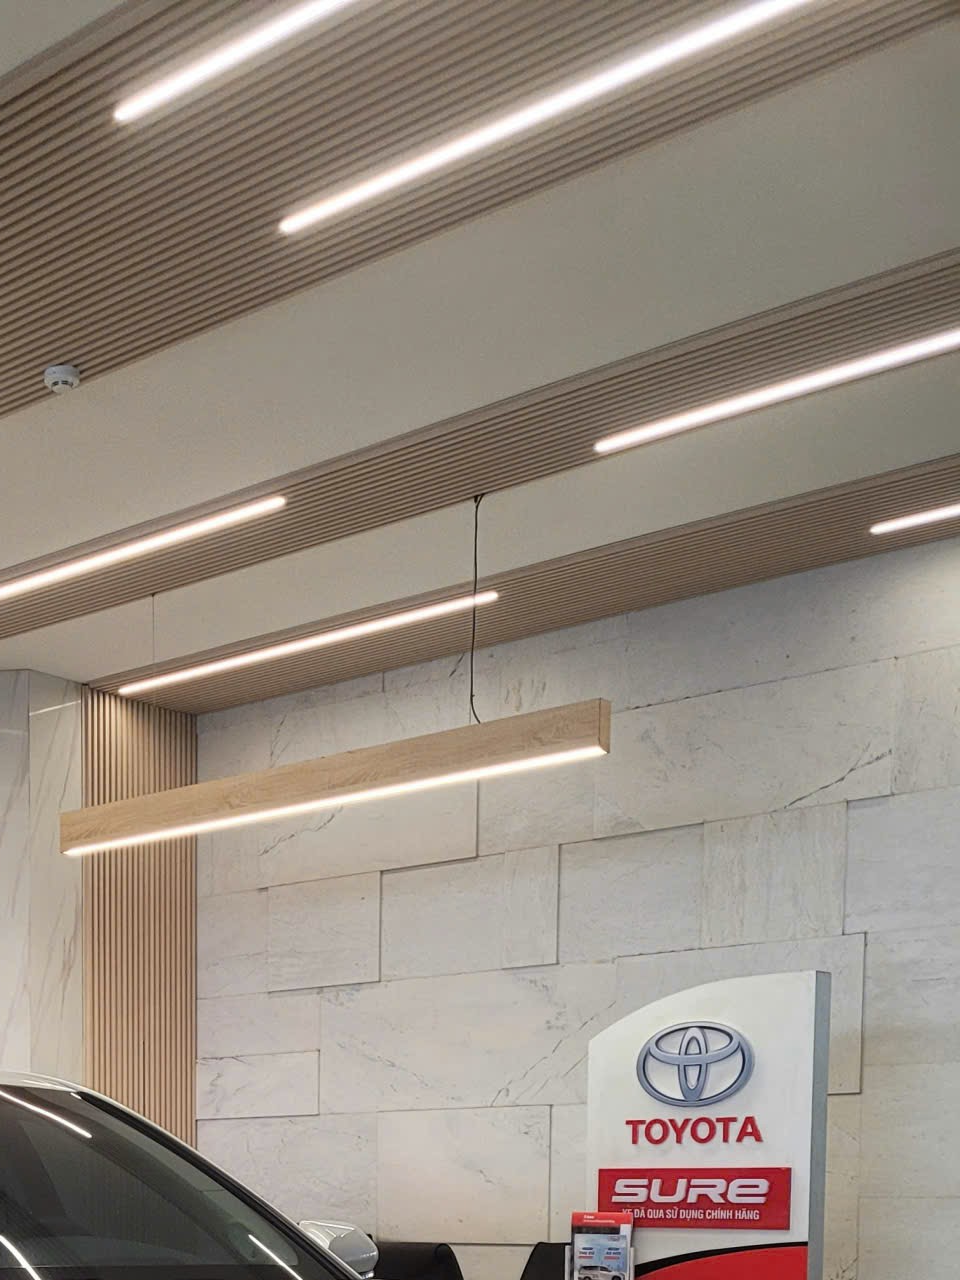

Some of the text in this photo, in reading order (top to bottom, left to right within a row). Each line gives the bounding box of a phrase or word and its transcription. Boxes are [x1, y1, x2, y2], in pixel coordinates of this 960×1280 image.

[625, 1115, 764, 1145] TOYOTA
[647, 1208, 665, 1219] QUA
[680, 1209, 704, 1221] DỤNG
[705, 1207, 733, 1220] CHÍNH
[735, 1207, 760, 1220] HÃNG
